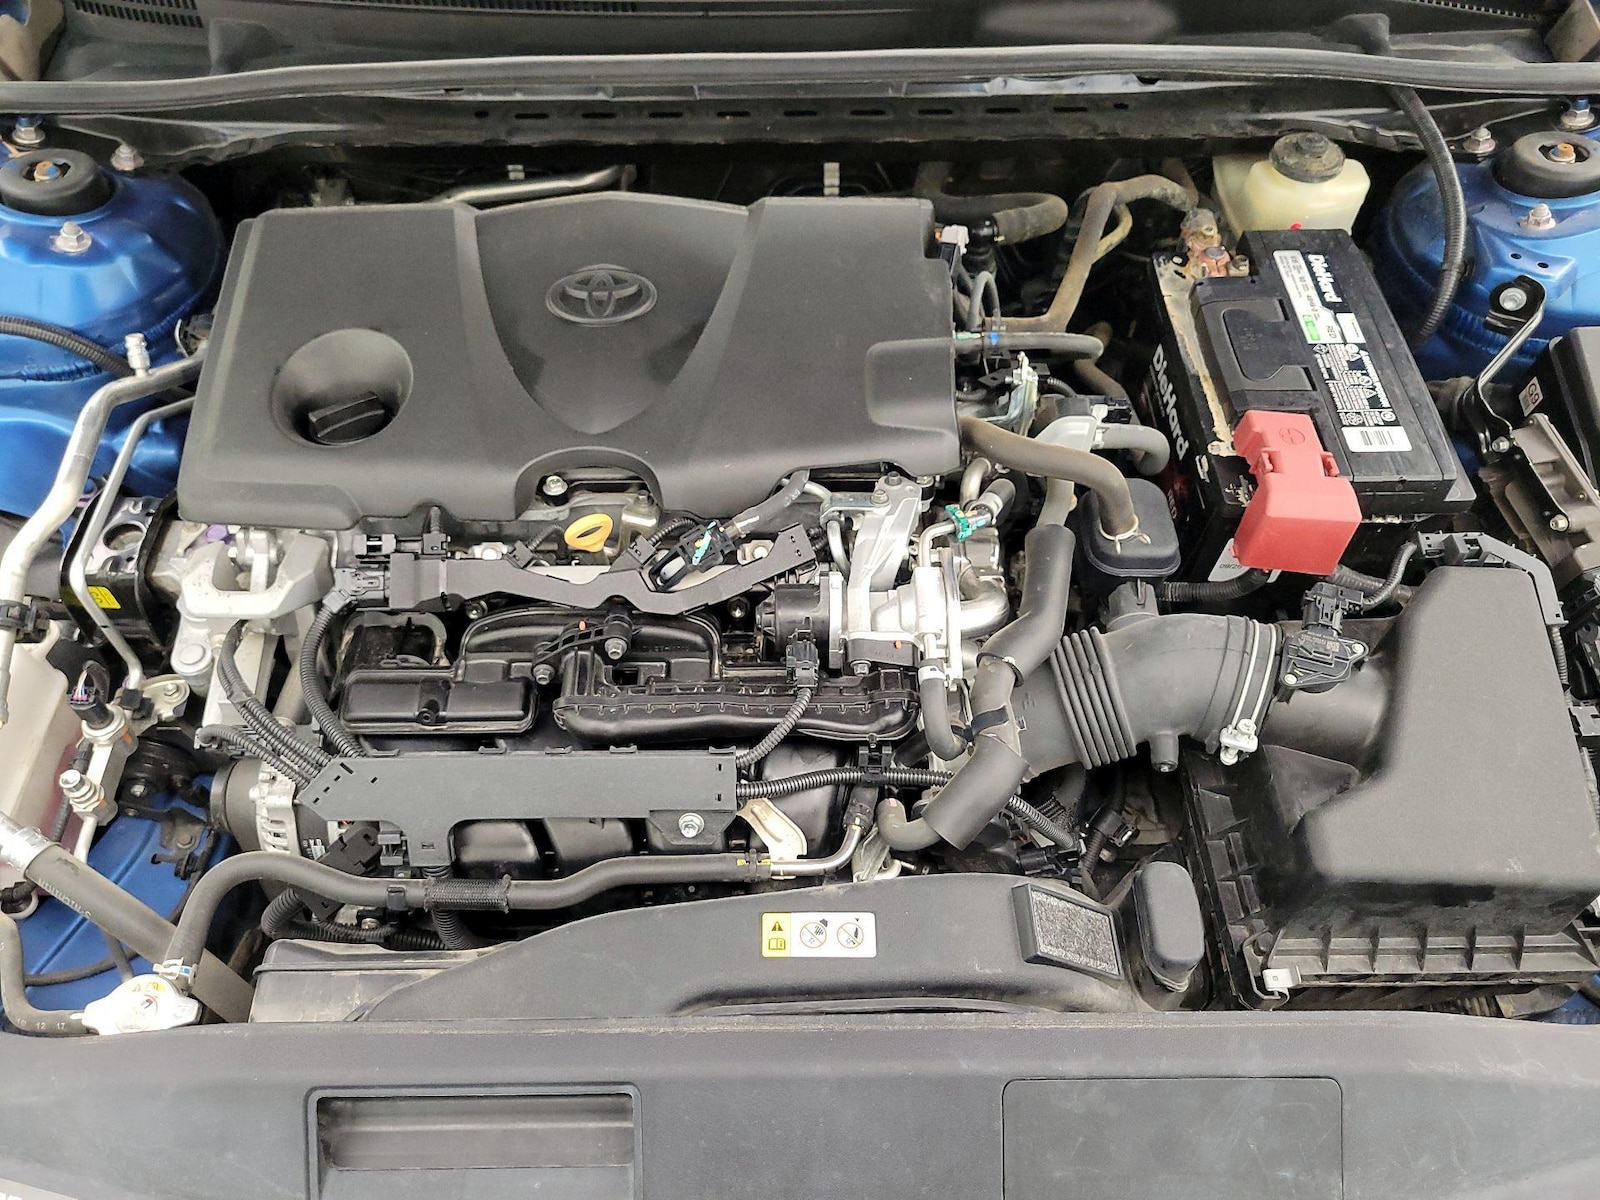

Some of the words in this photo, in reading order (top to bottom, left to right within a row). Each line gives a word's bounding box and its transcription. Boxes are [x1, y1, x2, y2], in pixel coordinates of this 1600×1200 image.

[1308, 253, 1343, 303] DieHard
[1152, 343, 1190, 461] DieHard
[1529, 383, 1540, 405] G9
[35, 1021, 47, 1030] 12
[56, 1022, 66, 1030] 17
